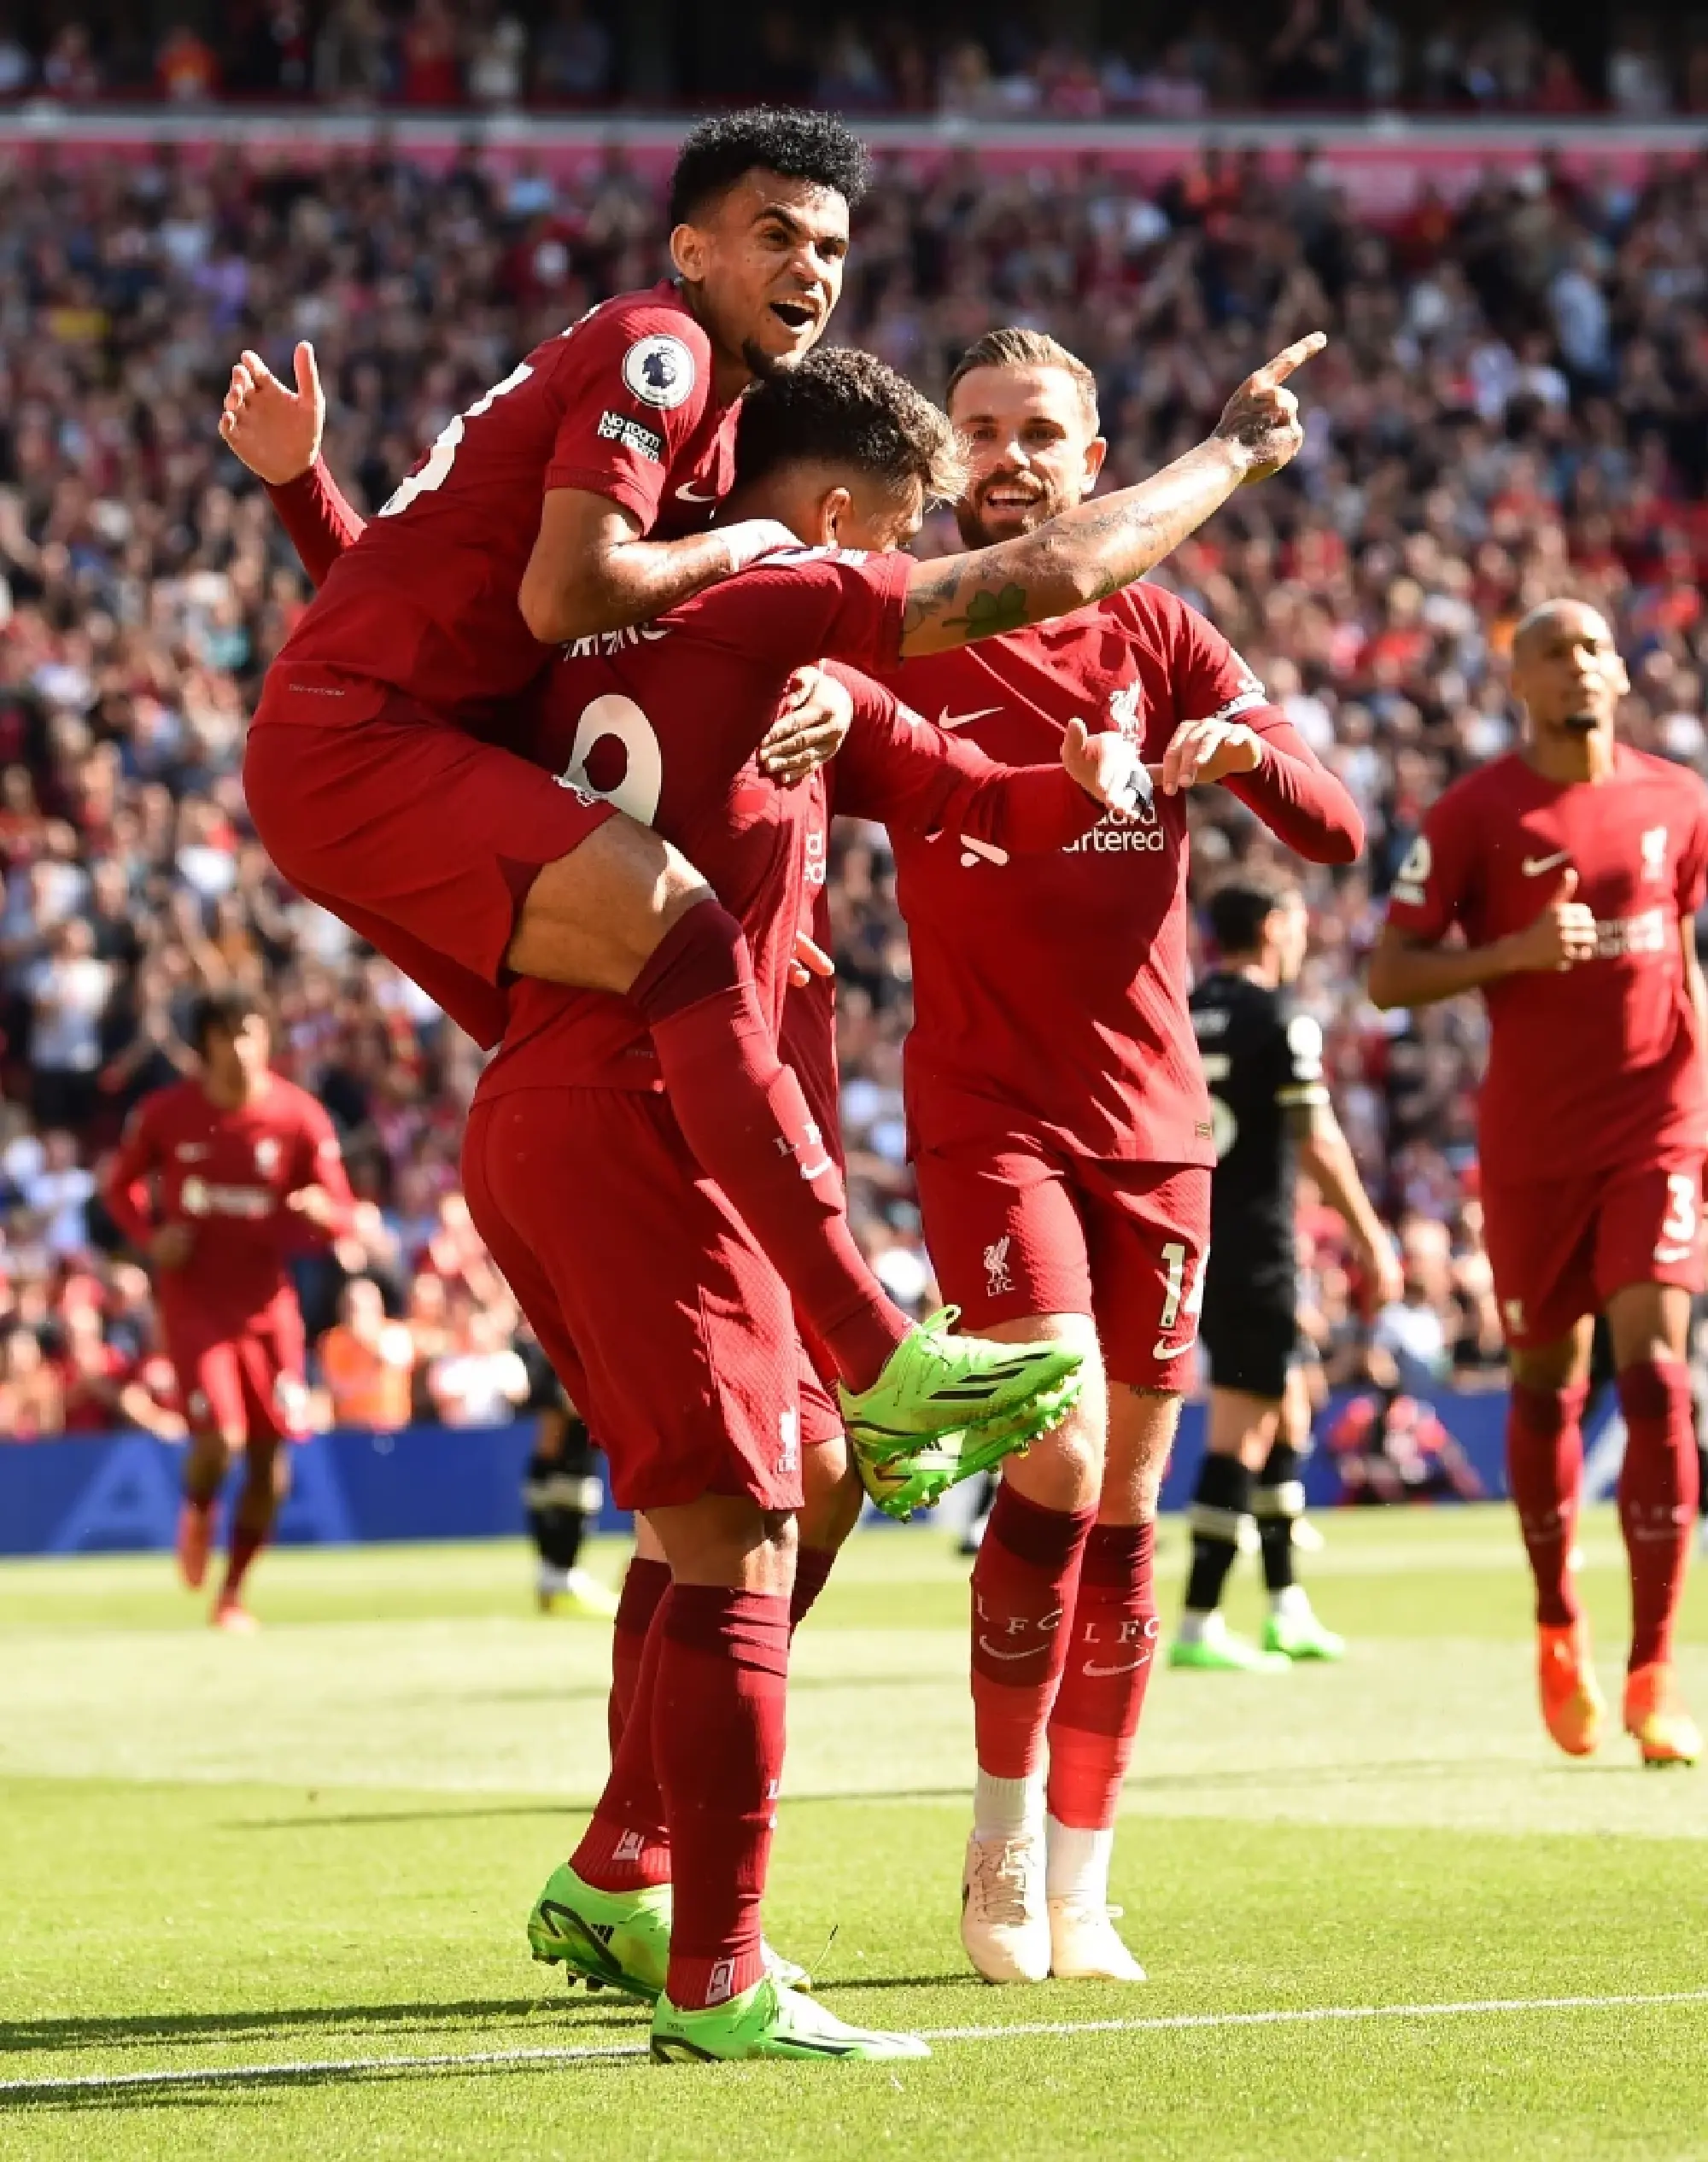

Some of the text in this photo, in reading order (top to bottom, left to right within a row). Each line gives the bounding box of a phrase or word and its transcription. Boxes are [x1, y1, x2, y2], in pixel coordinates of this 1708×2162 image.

[599, 412, 662, 448] No room
[564, 693, 663, 827] 9
[1662, 1174, 1695, 1241] 3
[1160, 1243, 1211, 1329] 14
